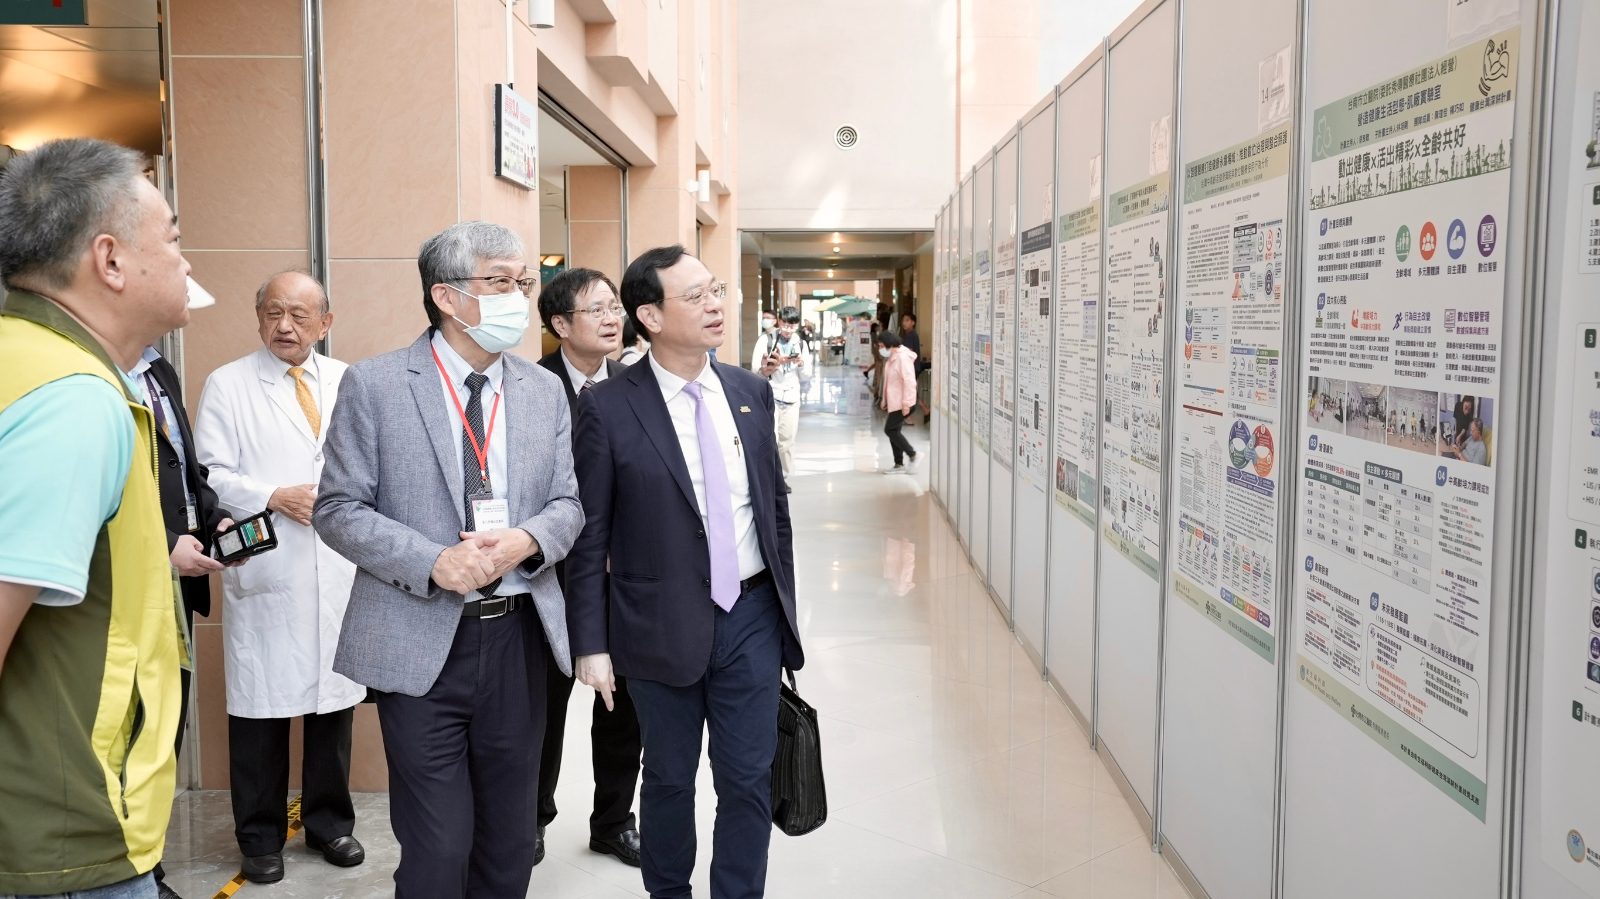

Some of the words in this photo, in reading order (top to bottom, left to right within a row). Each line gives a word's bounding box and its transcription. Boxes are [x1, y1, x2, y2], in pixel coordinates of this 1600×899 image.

[1446, 263, 1467, 275] 自主運動
[1588, 334, 1594, 344] 3
